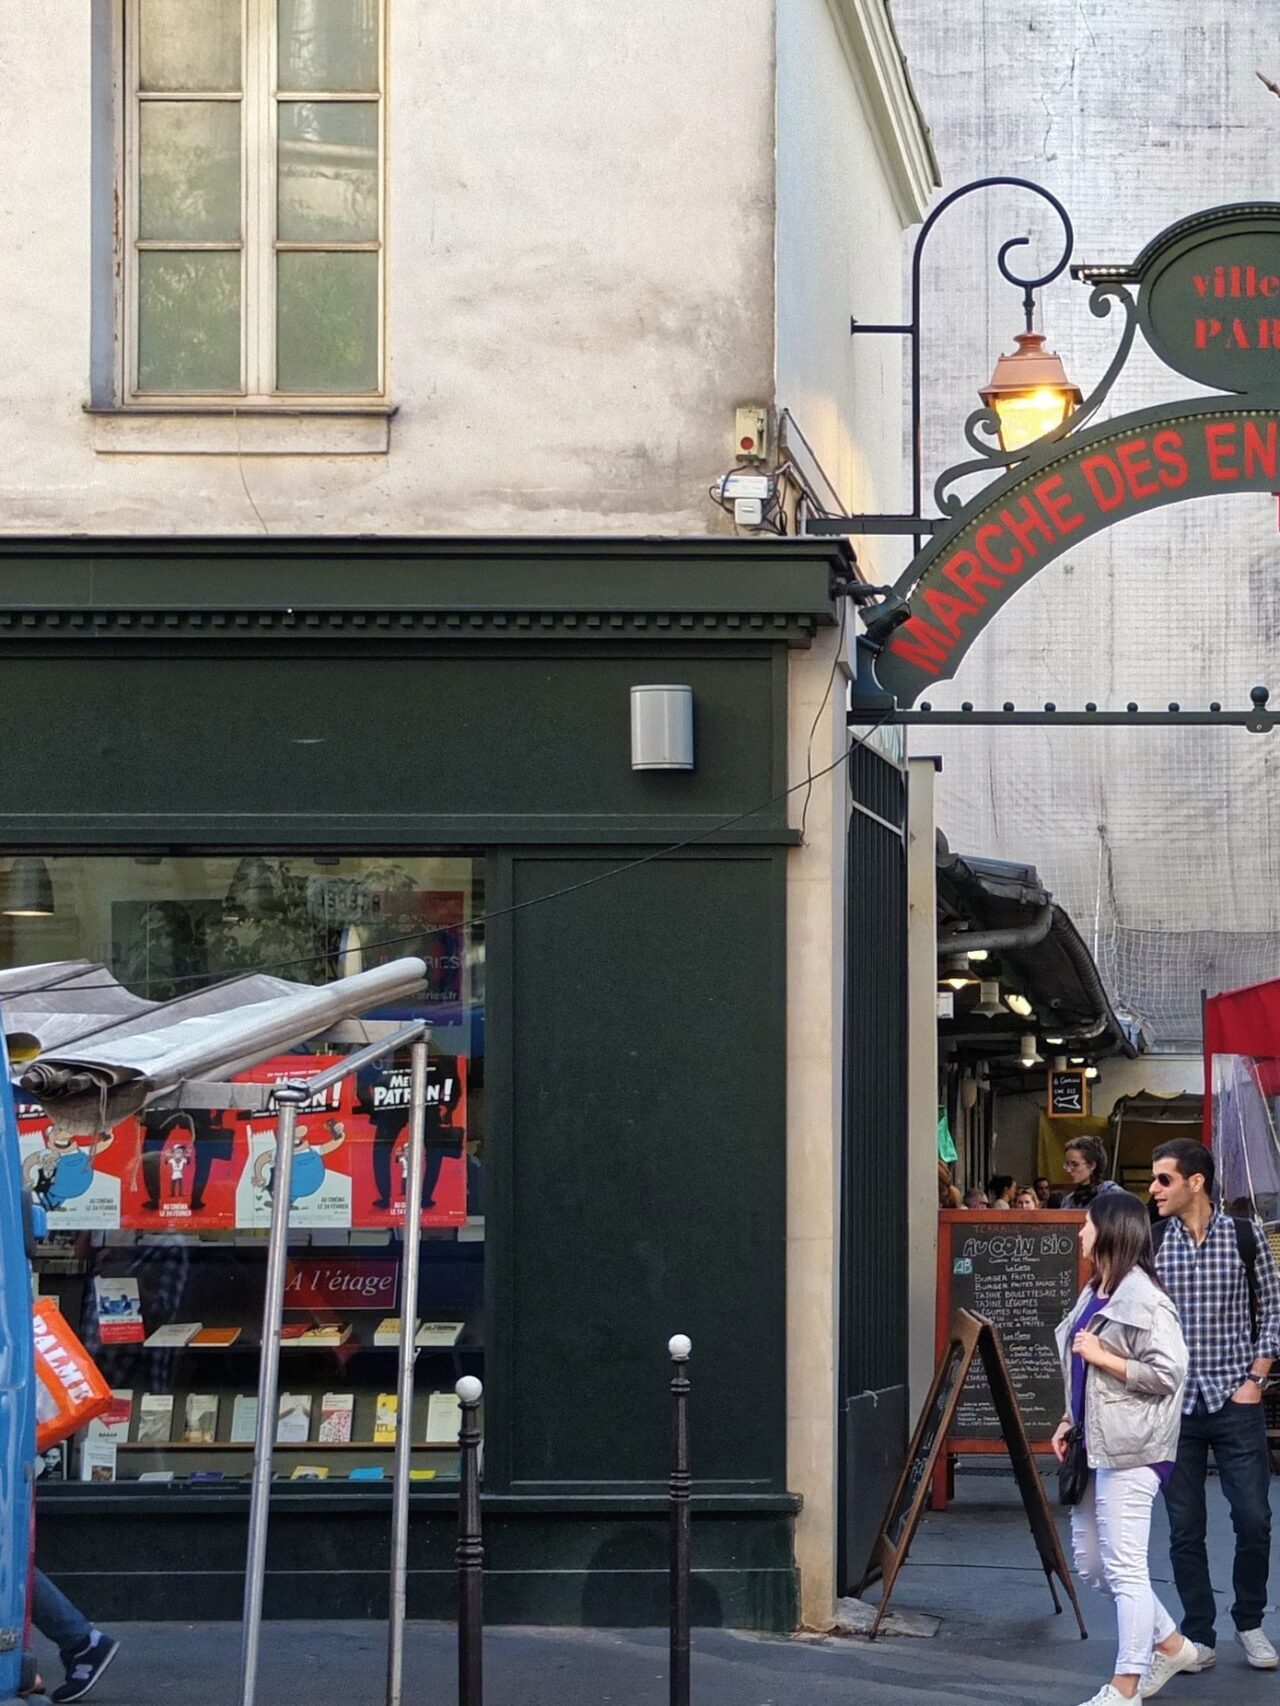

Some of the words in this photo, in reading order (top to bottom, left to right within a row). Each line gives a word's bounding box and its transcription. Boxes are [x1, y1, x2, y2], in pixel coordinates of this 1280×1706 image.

[1193, 265, 1280, 298] ville
[890, 474, 1086, 676] MARCHE
[1080, 429, 1191, 514] DES
[373, 1085, 441, 1107] PATRN
[988, 1234, 1036, 1258] COIN
[1040, 1233, 1074, 1255] BIO
[284, 1271, 304, 1291] A
[310, 1269, 393, 1297] l'étage
